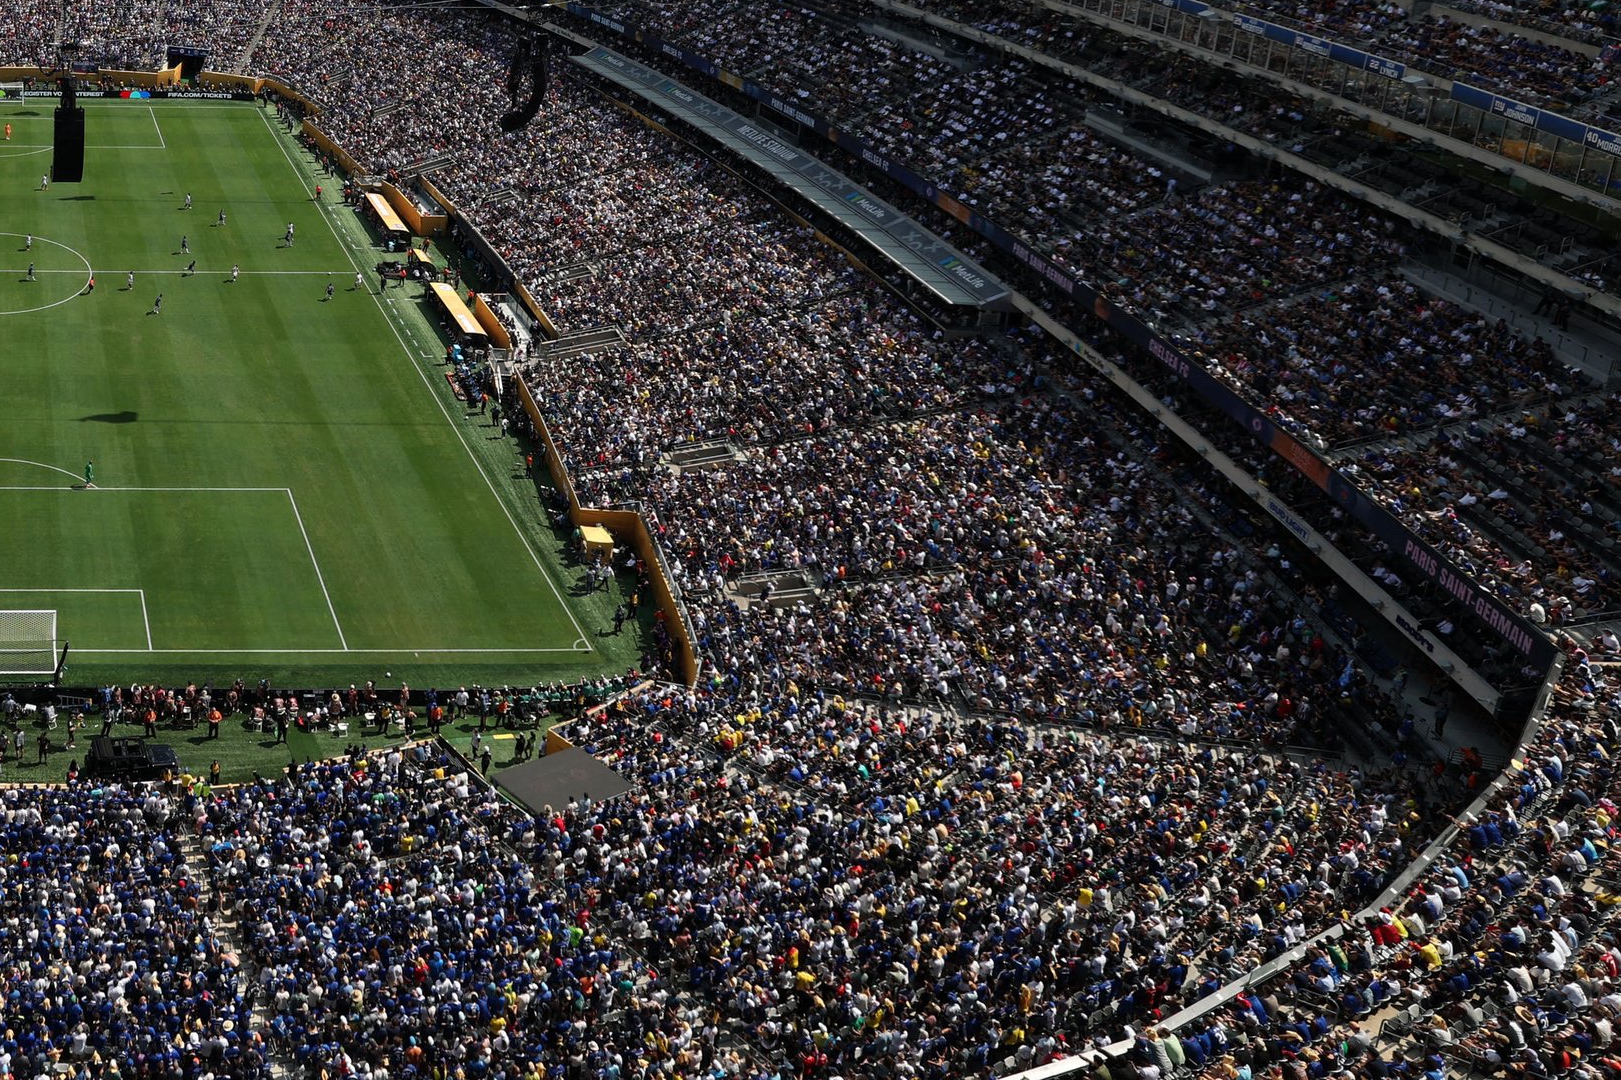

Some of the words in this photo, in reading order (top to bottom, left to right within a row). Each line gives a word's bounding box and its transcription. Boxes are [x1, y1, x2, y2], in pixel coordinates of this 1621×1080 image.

[662, 44, 677, 57] CHELSEA
[677, 50, 683, 60] FC
[1369, 59, 1379, 69] 22
[1379, 66, 1399, 79] LYNCH
[674, 89, 693, 102] MetLife
[771, 97, 783, 112] PARIS
[783, 104, 815, 128] SAINT-GERMAIN
[1503, 107, 1535, 125] JOHNSON
[736, 124, 770, 146] METLIFE
[762, 140, 798, 161] STADIUM
[1587, 131, 1599, 143] 40
[1596, 139, 1621, 156] MORRI
[862, 149, 882, 167] CHELSEA
[882, 161, 890, 172] FC
[857, 199, 885, 218] MetLife
[952, 265, 985, 288] MetLife
[1012, 242, 1029, 262] PARIS
[1029, 254, 1075, 294] SAINT-GERMAIN
[1148, 338, 1178, 370] CHELSEA
[1178, 361, 1190, 378] FC
[1268, 502, 1286, 520] BUD
[1284, 516, 1308, 539] LIGHT
[1404, 539, 1438, 577] PARIS
[1439, 568, 1534, 656] SAINT-GERMAIN
